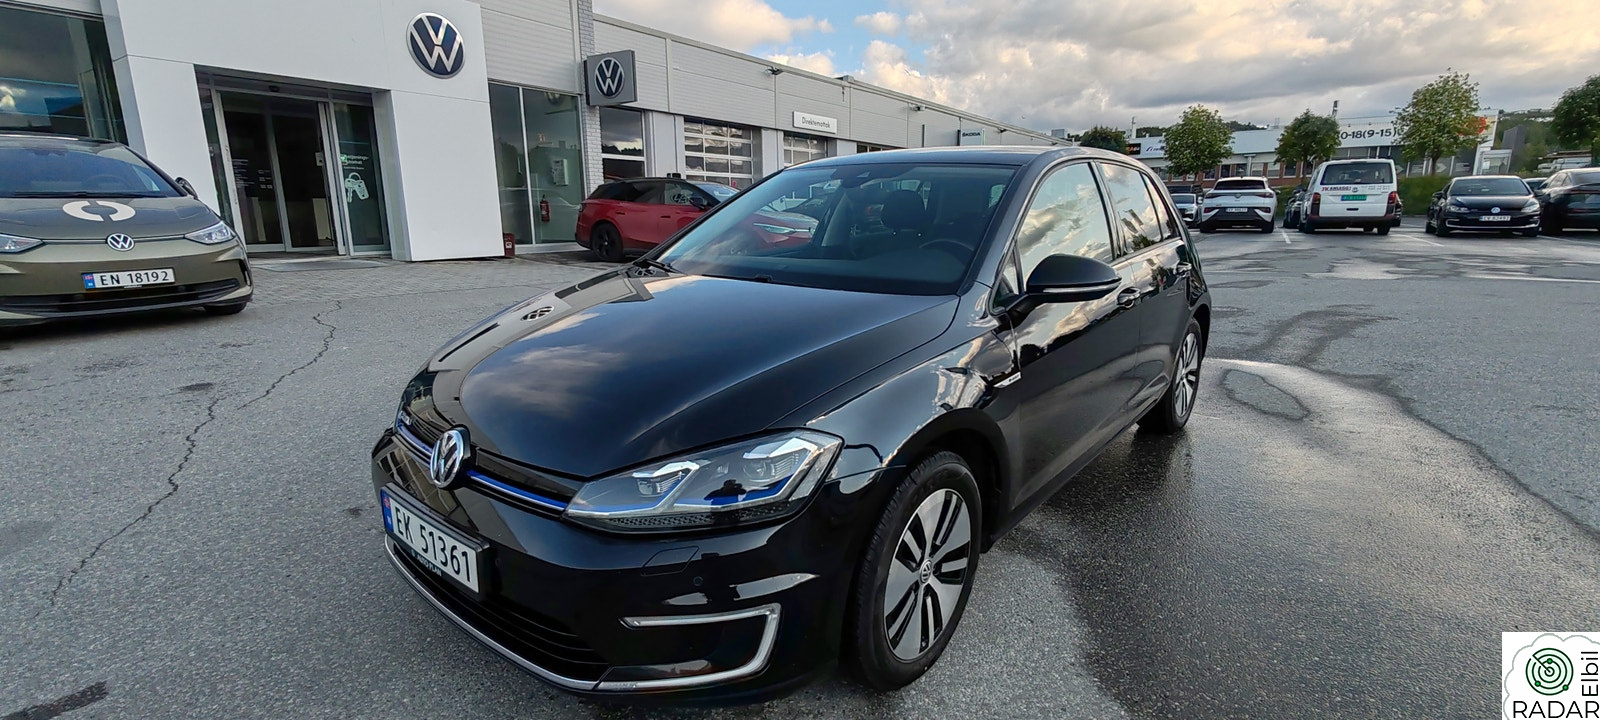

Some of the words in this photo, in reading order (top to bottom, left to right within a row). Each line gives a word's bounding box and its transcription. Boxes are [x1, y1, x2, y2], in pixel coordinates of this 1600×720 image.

[408, 13, 463, 76] VW
[595, 57, 623, 97] VW
[100, 274, 120, 286] EN
[127, 270, 169, 284] 18192
[394, 506, 414, 544] EK
[419, 523, 471, 583] 51361
